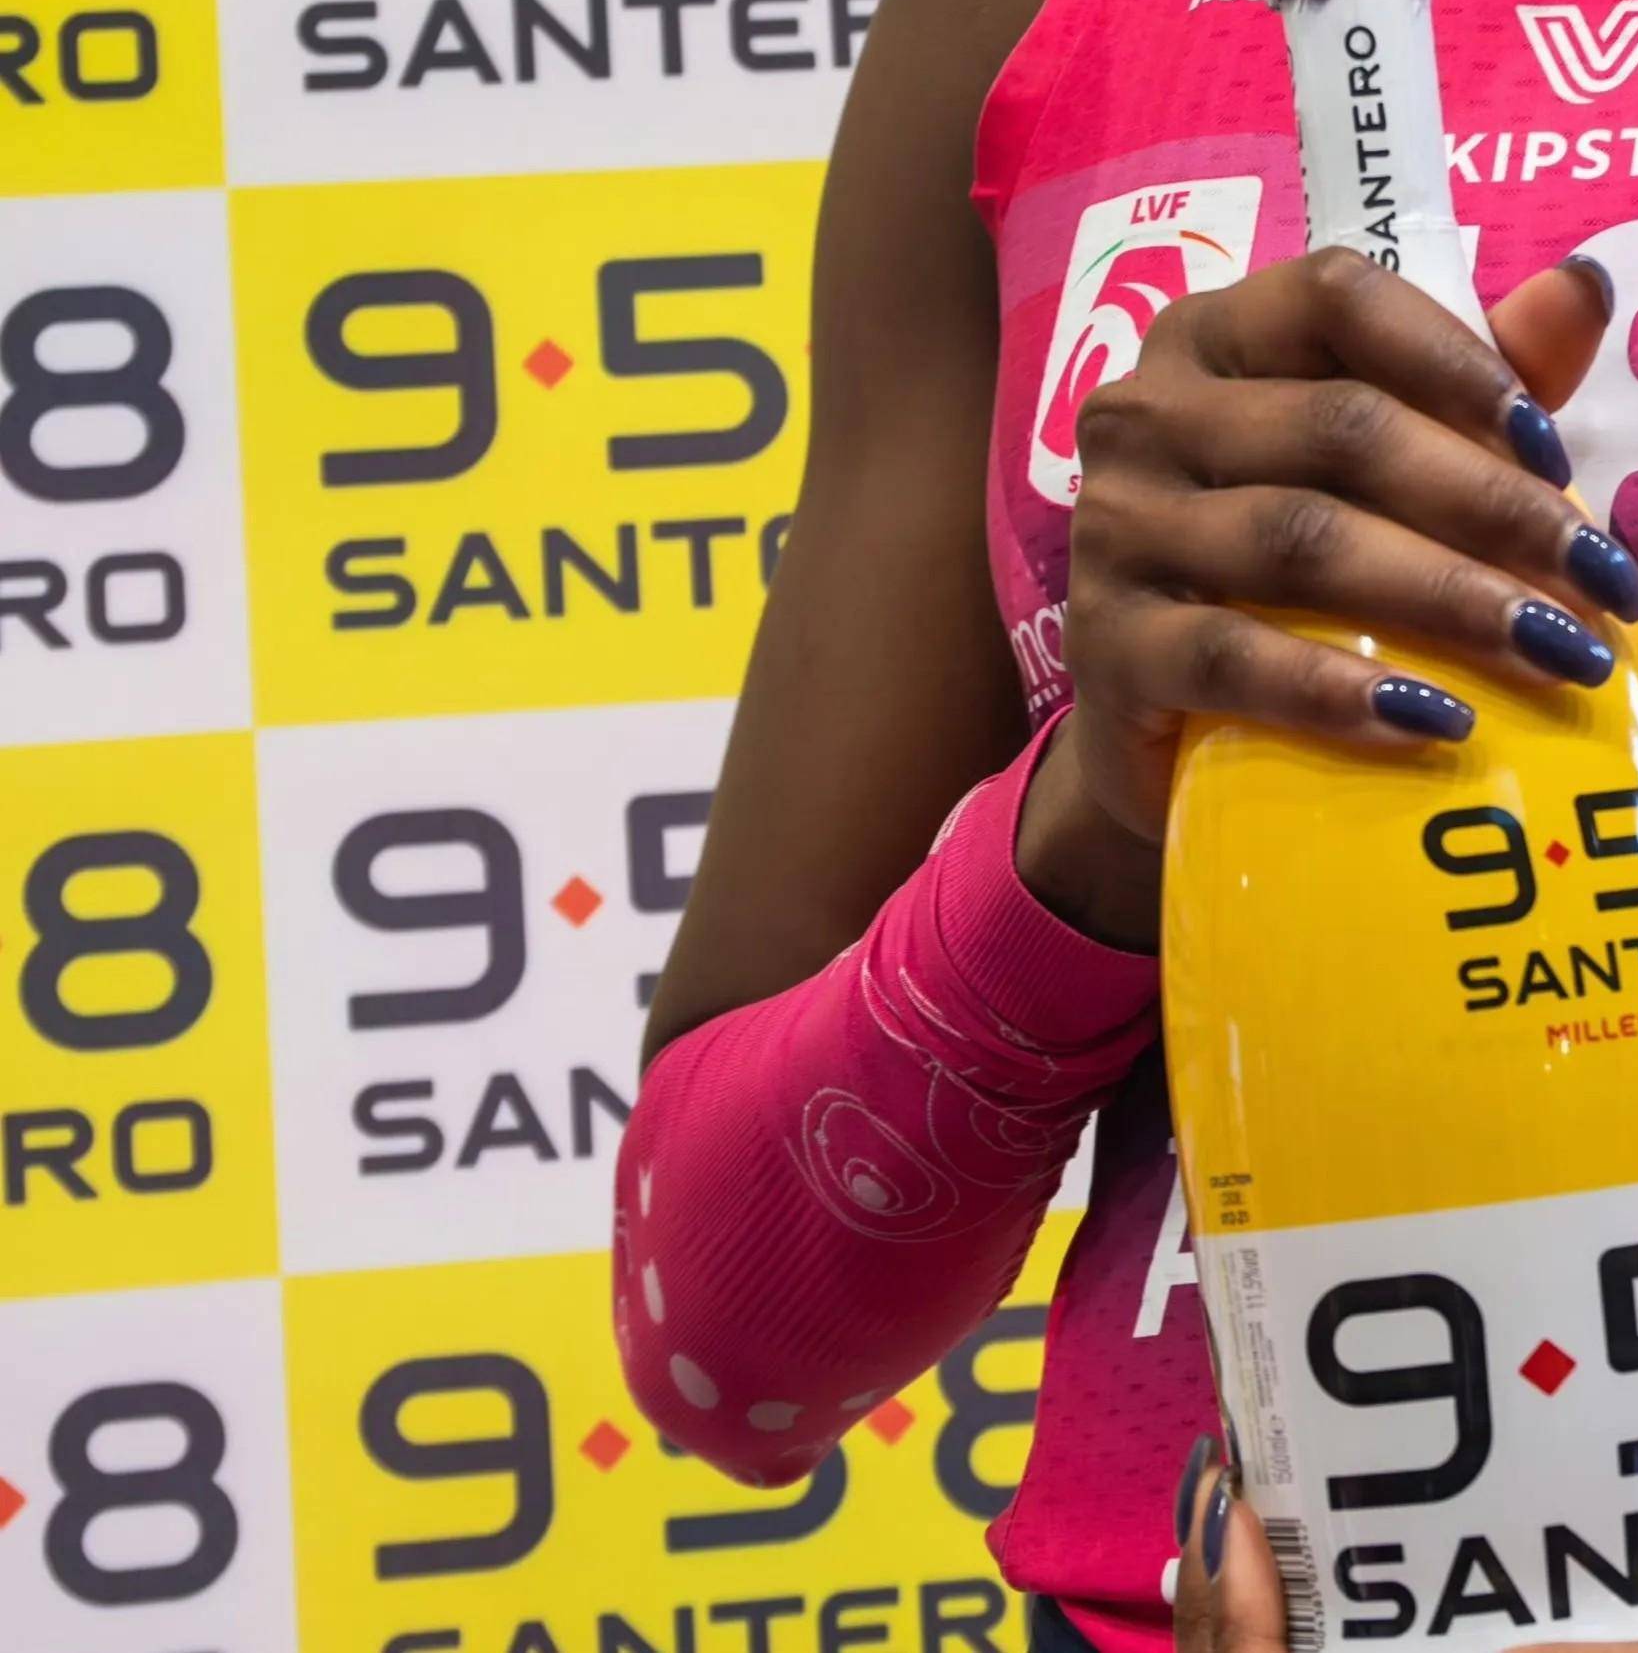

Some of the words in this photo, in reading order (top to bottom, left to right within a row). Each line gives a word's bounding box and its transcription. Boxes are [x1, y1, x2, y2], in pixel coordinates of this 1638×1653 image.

[1129, 190, 1191, 226] LVF
[1343, 24, 1400, 275] SANTERO
[325, 512, 796, 631] SANT
